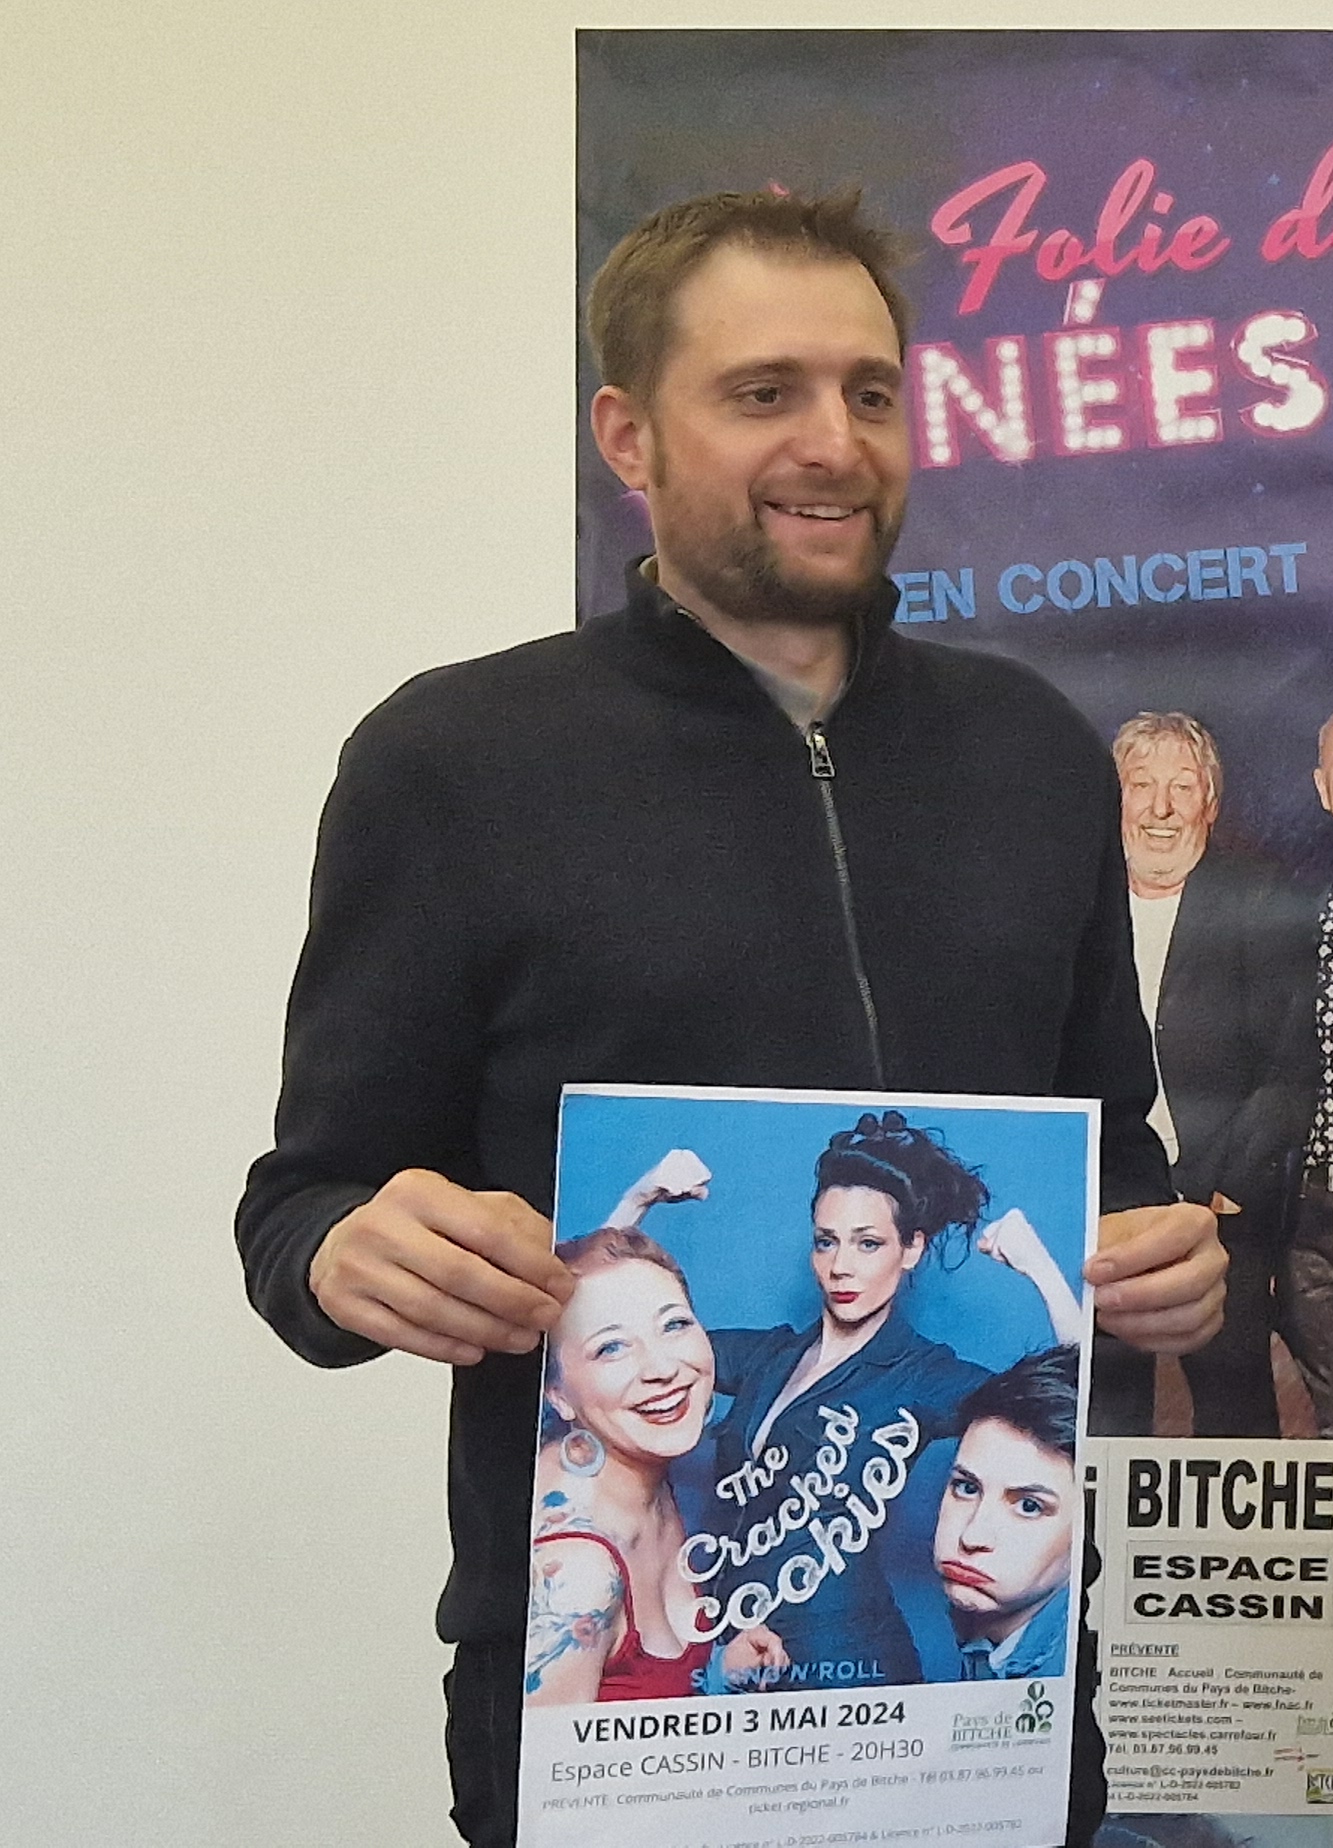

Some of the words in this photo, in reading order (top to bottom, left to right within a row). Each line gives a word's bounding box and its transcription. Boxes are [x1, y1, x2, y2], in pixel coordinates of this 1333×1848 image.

[930, 157, 1233, 315] Folie
[915, 278, 1328, 470] NÉES
[893, 567, 976, 626] EN
[999, 541, 1307, 616] CONCERT
[717, 1444, 789, 1508] The
[678, 1403, 861, 1584] Cracked
[1133, 1555, 1328, 1581] ESPACE
[1134, 1593, 1323, 1619] CASSIN
[1111, 1643, 1179, 1658] PRÉVENTE
[1110, 1667, 1156, 1678] BITCHE
[1168, 1667, 1214, 1679] Accueil
[1225, 1668, 1304, 1680] Communauté
[1309, 1670, 1323, 1680] de
[1109, 1683, 1178, 1694] Communes
[1183, 1683, 1198, 1694] du
[1202, 1683, 1230, 1697] Pays
[1235, 1684, 1249, 1694] de
[1109, 1699, 1229, 1710] www.ticketmaster.fr
[1243, 1701, 1313, 1711] www.fnac.fr
[573, 1710, 731, 1743] VENDREDI
[743, 1709, 759, 1732] 3
[770, 1706, 827, 1730] MAI
[837, 1702, 905, 1727] 2024
[953, 1713, 989, 1728] Pays
[1109, 1715, 1232, 1725] www.seetickets.com
[1109, 1730, 1277, 1742] www.spectacles.carrefour.fr
[552, 1760, 632, 1786] Espace
[641, 1751, 724, 1776] CASSIN
[748, 1744, 829, 1768] BITCHE
[851, 1739, 923, 1761] 20H30
[617, 1788, 703, 1805] Communauté
[707, 1788, 723, 1799] de
[726, 1783, 798, 1797] Communes
[801, 1780, 817, 1792] du
[821, 1781, 848, 1796] Pays
[852, 1778, 867, 1788] de
